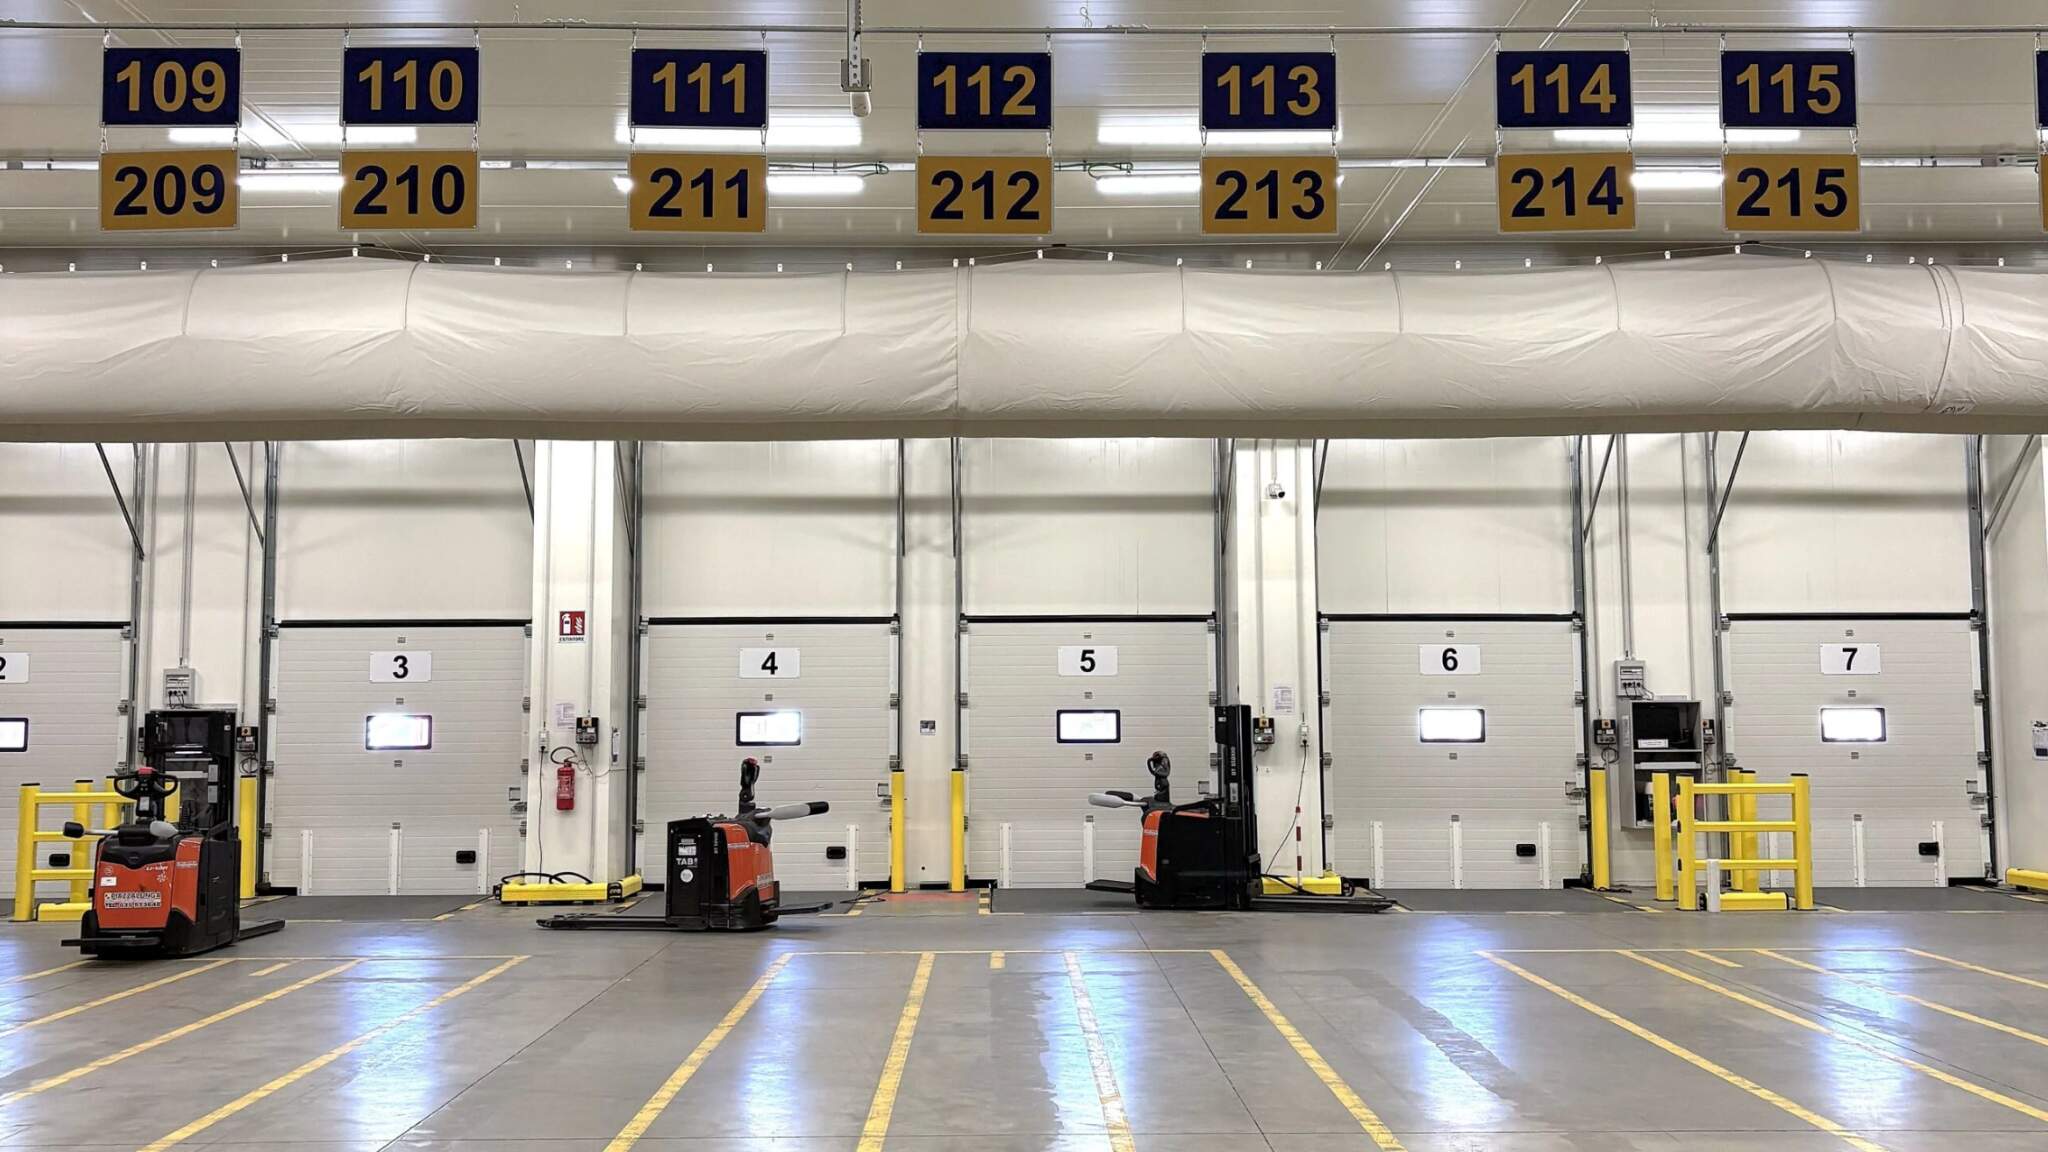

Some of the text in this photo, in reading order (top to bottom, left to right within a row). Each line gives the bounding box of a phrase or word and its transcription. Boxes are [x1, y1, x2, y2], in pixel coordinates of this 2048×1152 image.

[116, 62, 225, 112] 109
[358, 60, 463, 110] 110
[653, 63, 745, 113] 111
[932, 65, 1035, 115] 112
[1217, 66, 1320, 116] 113
[1511, 64, 1616, 113] 114
[1736, 63, 1841, 113] 115
[114, 163, 226, 217] 209
[353, 164, 465, 216] 210
[648, 167, 749, 219] 211
[930, 169, 1041, 221] 212
[1215, 169, 1325, 221] 213
[1511, 165, 1624, 218] 214
[1736, 167, 1848, 218] 215
[392, 655, 409, 679] 3
[761, 651, 779, 675] 4
[1080, 649, 1096, 673] 5
[1442, 647, 1459, 672] 6
[1842, 647, 1858, 671] 7
